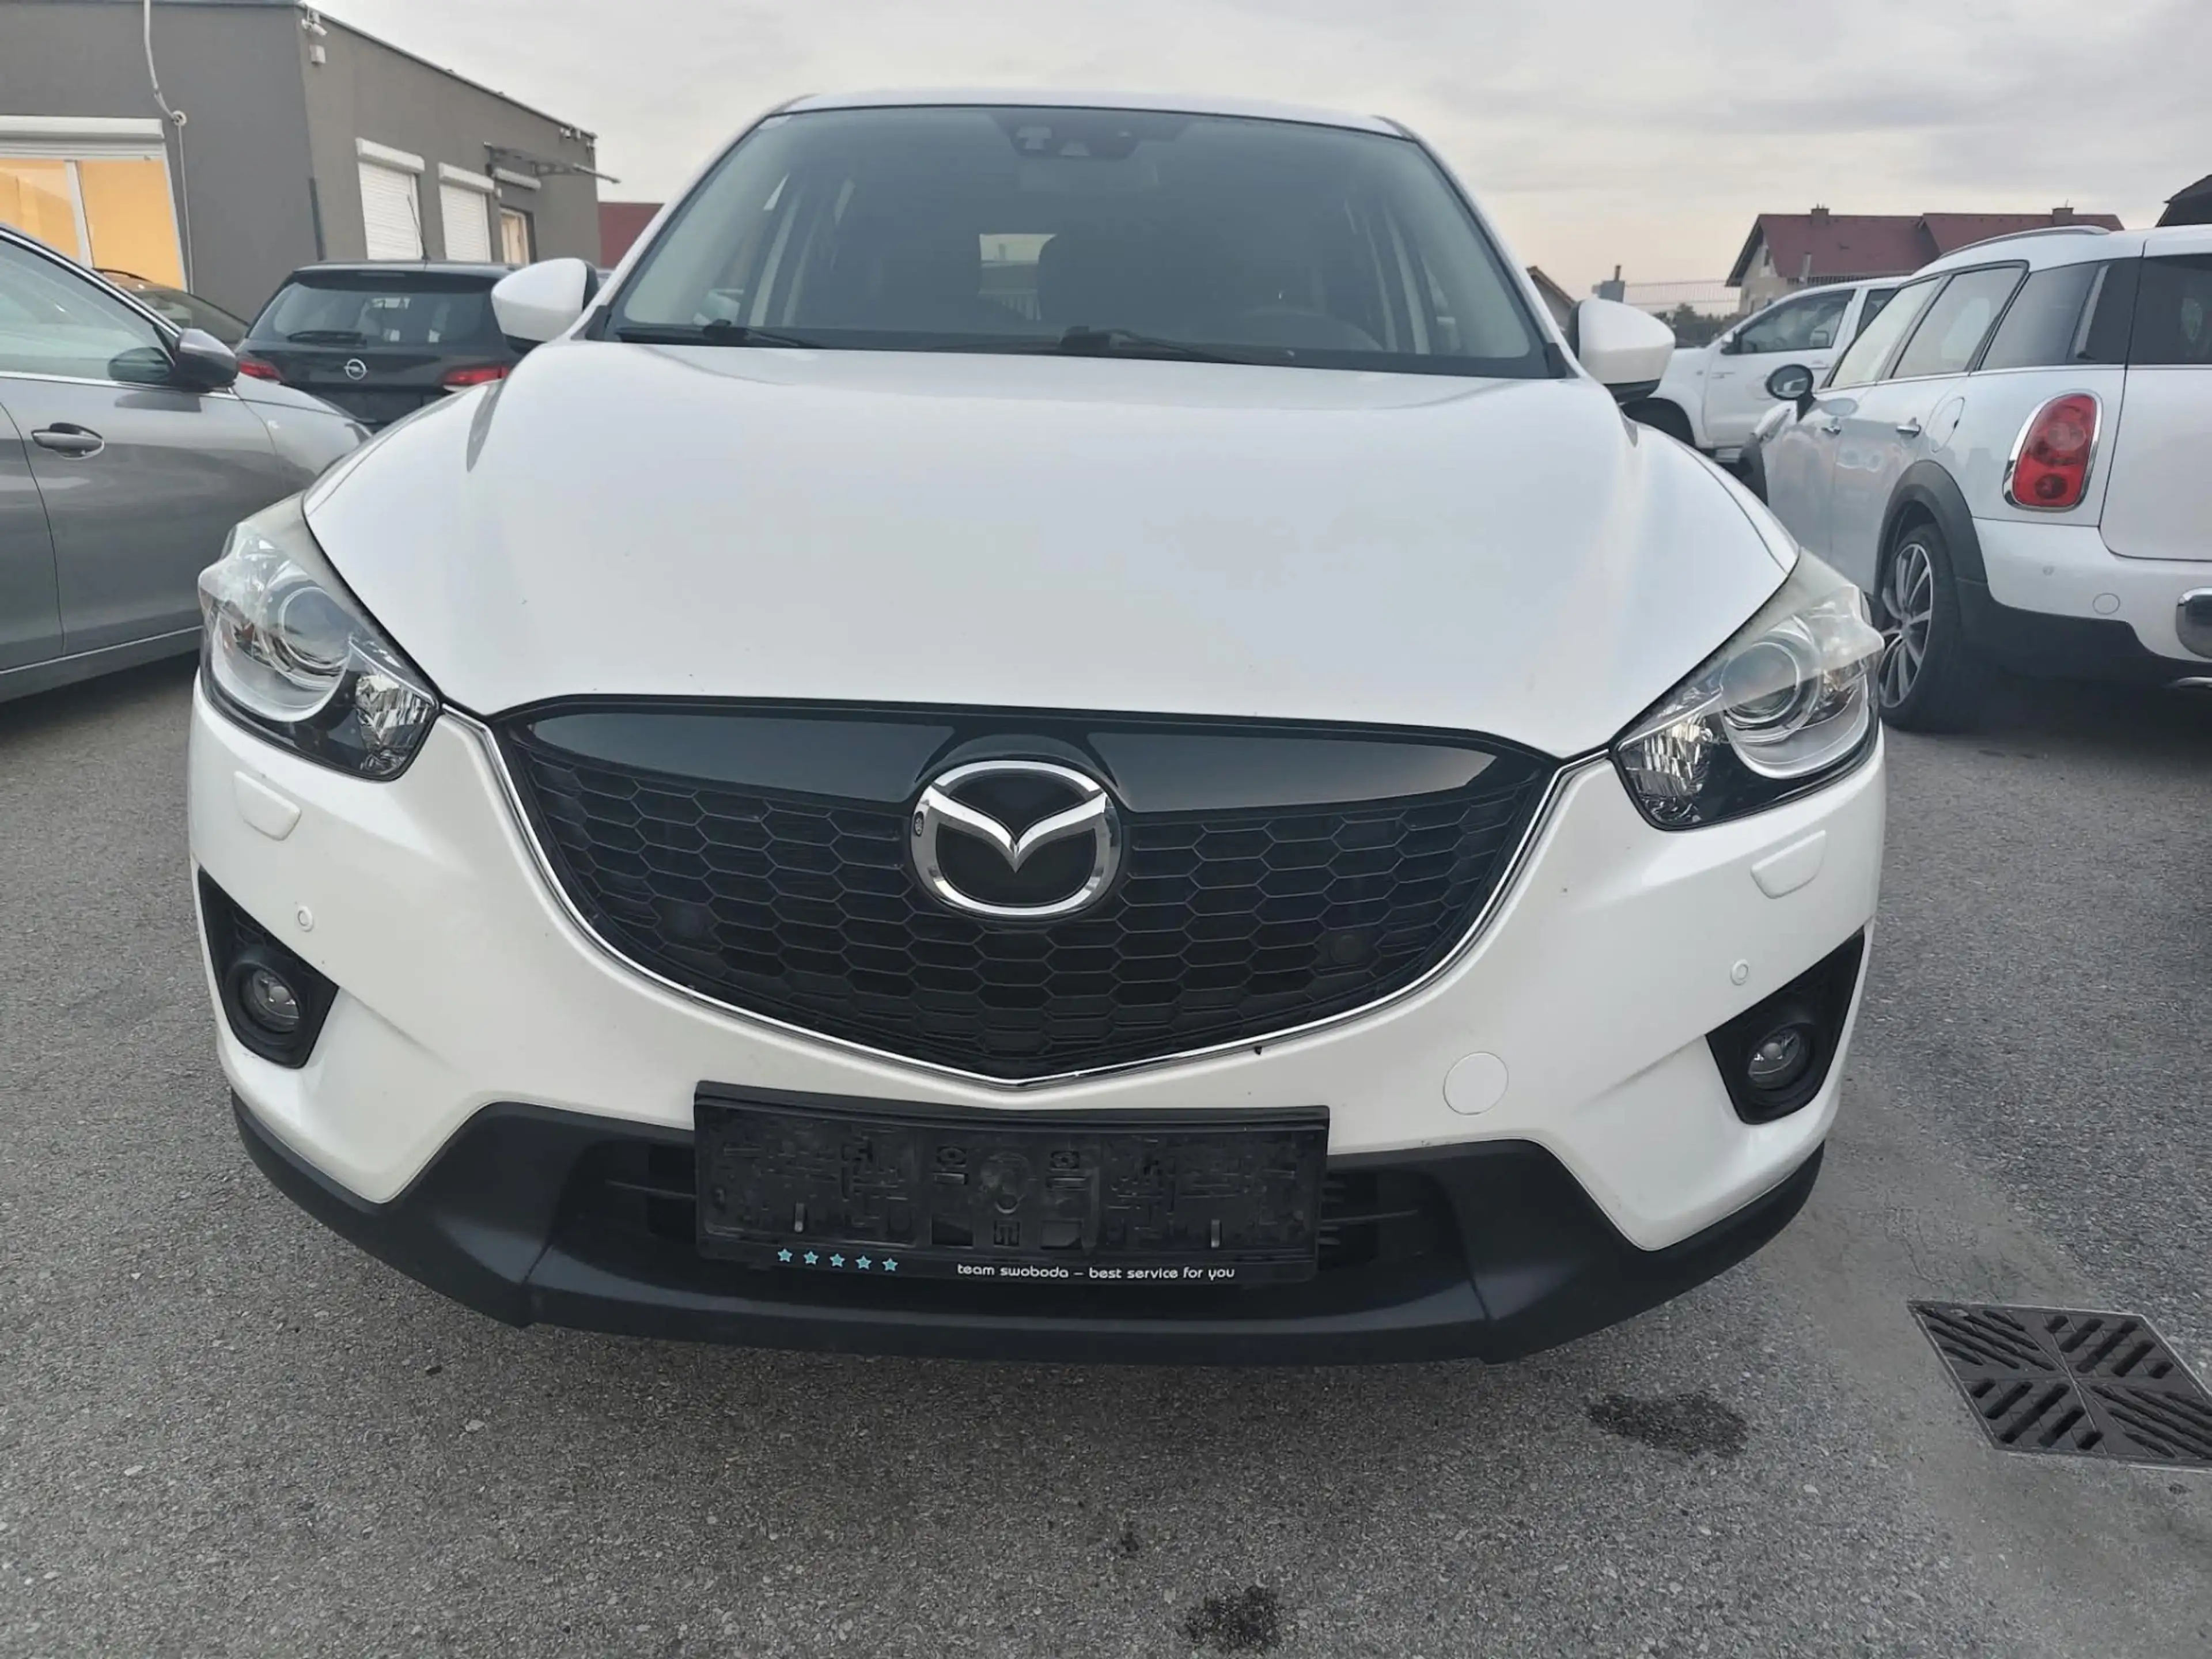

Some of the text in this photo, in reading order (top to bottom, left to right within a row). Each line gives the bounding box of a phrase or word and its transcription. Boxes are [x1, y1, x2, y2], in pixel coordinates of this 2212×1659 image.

[957, 1264, 995, 1275] team
[1000, 1266, 1069, 1278] swoboda
[1089, 1267, 1122, 1279] best
[1127, 1268, 1179, 1279] service
[1183, 1267, 1203, 1279] for
[1208, 1268, 1235, 1281] you
